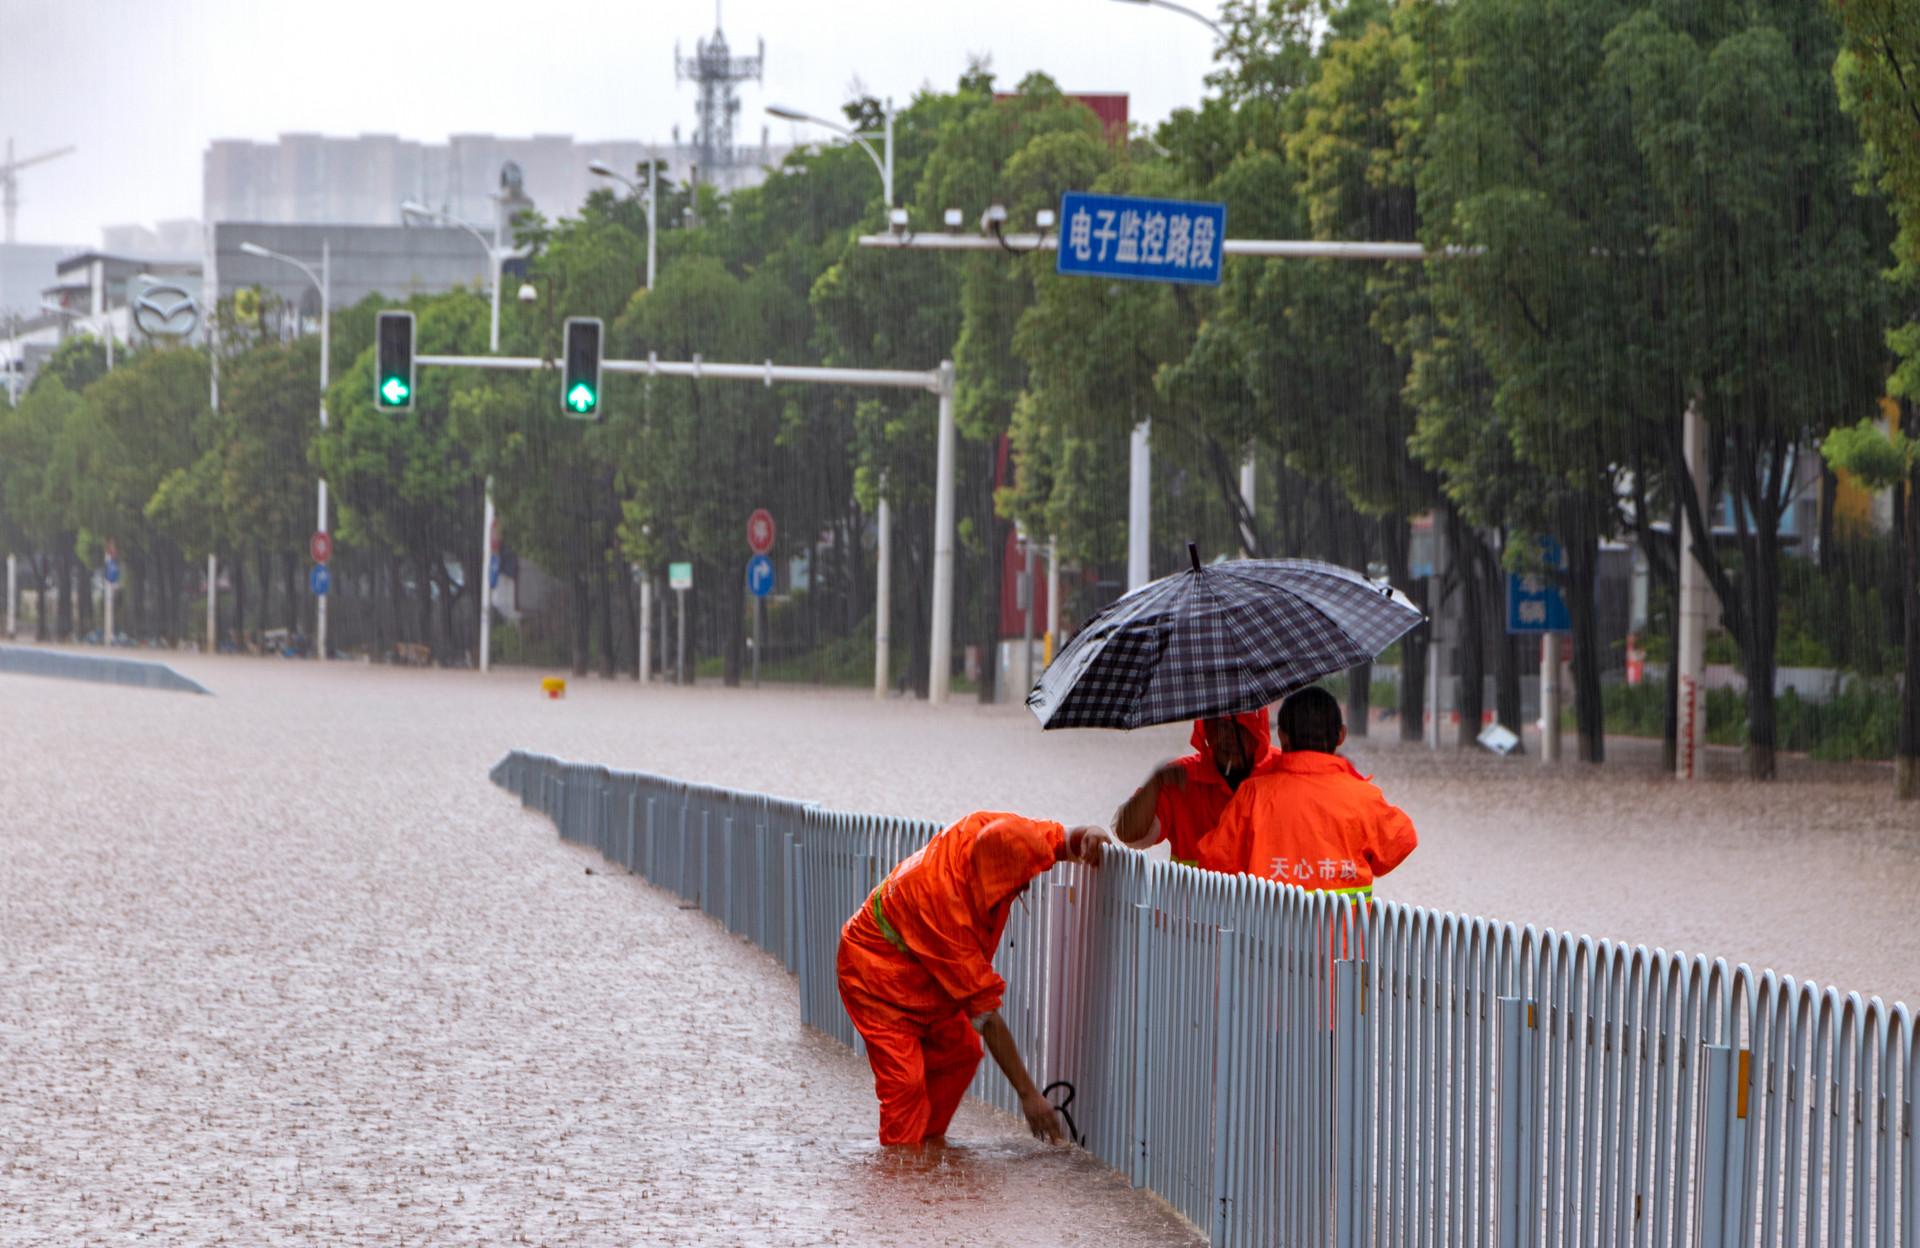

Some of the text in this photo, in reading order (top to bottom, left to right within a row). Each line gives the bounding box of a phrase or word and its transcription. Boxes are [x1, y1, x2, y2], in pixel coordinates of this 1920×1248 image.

[1069, 205, 1216, 269] 电子监控路段
[1270, 857, 1358, 880] 天心市政
